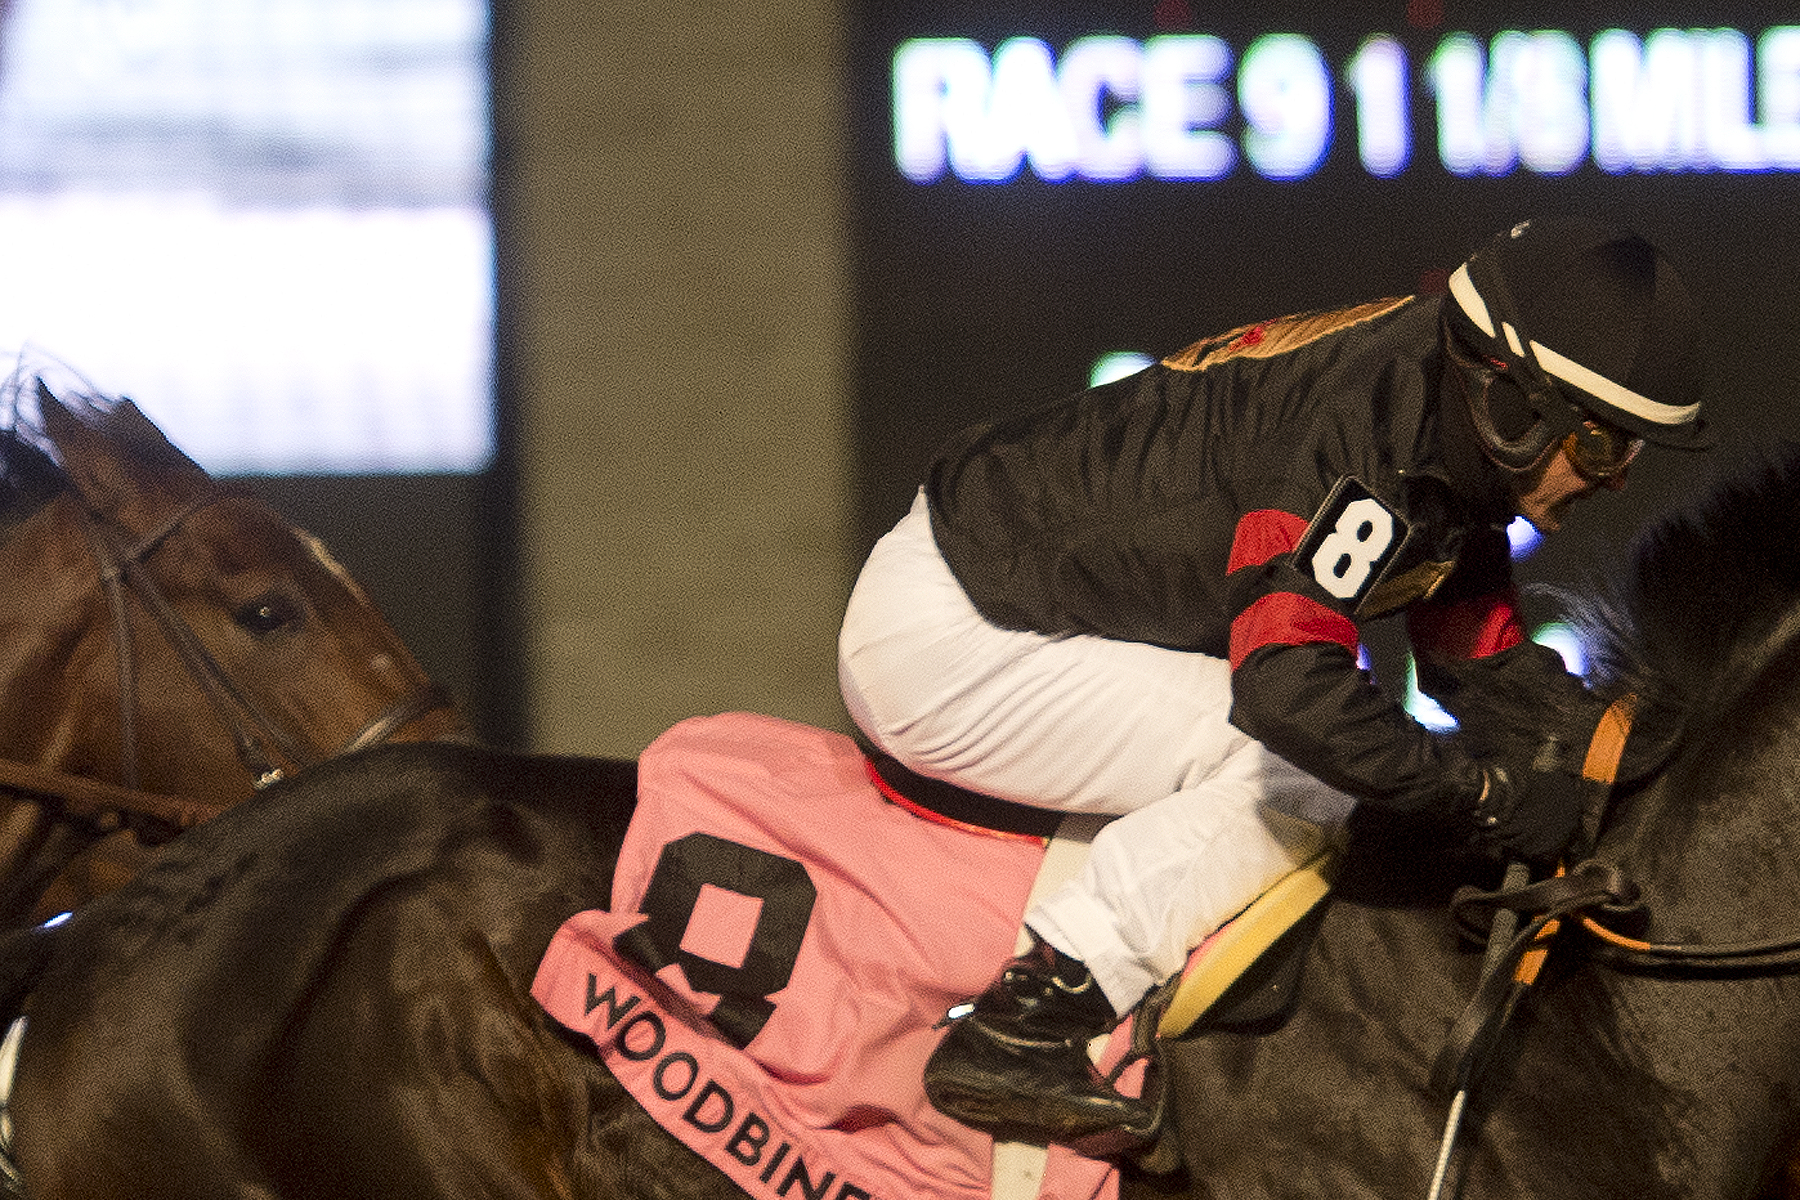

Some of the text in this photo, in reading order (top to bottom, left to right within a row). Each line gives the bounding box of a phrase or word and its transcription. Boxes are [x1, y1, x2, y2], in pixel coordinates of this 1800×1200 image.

[892, 35, 1232, 180] RACE
[1237, 34, 1330, 176] 9
[1348, 37, 1408, 174] 1
[1427, 30, 1590, 172] 1/8
[1311, 498, 1394, 600] 8
